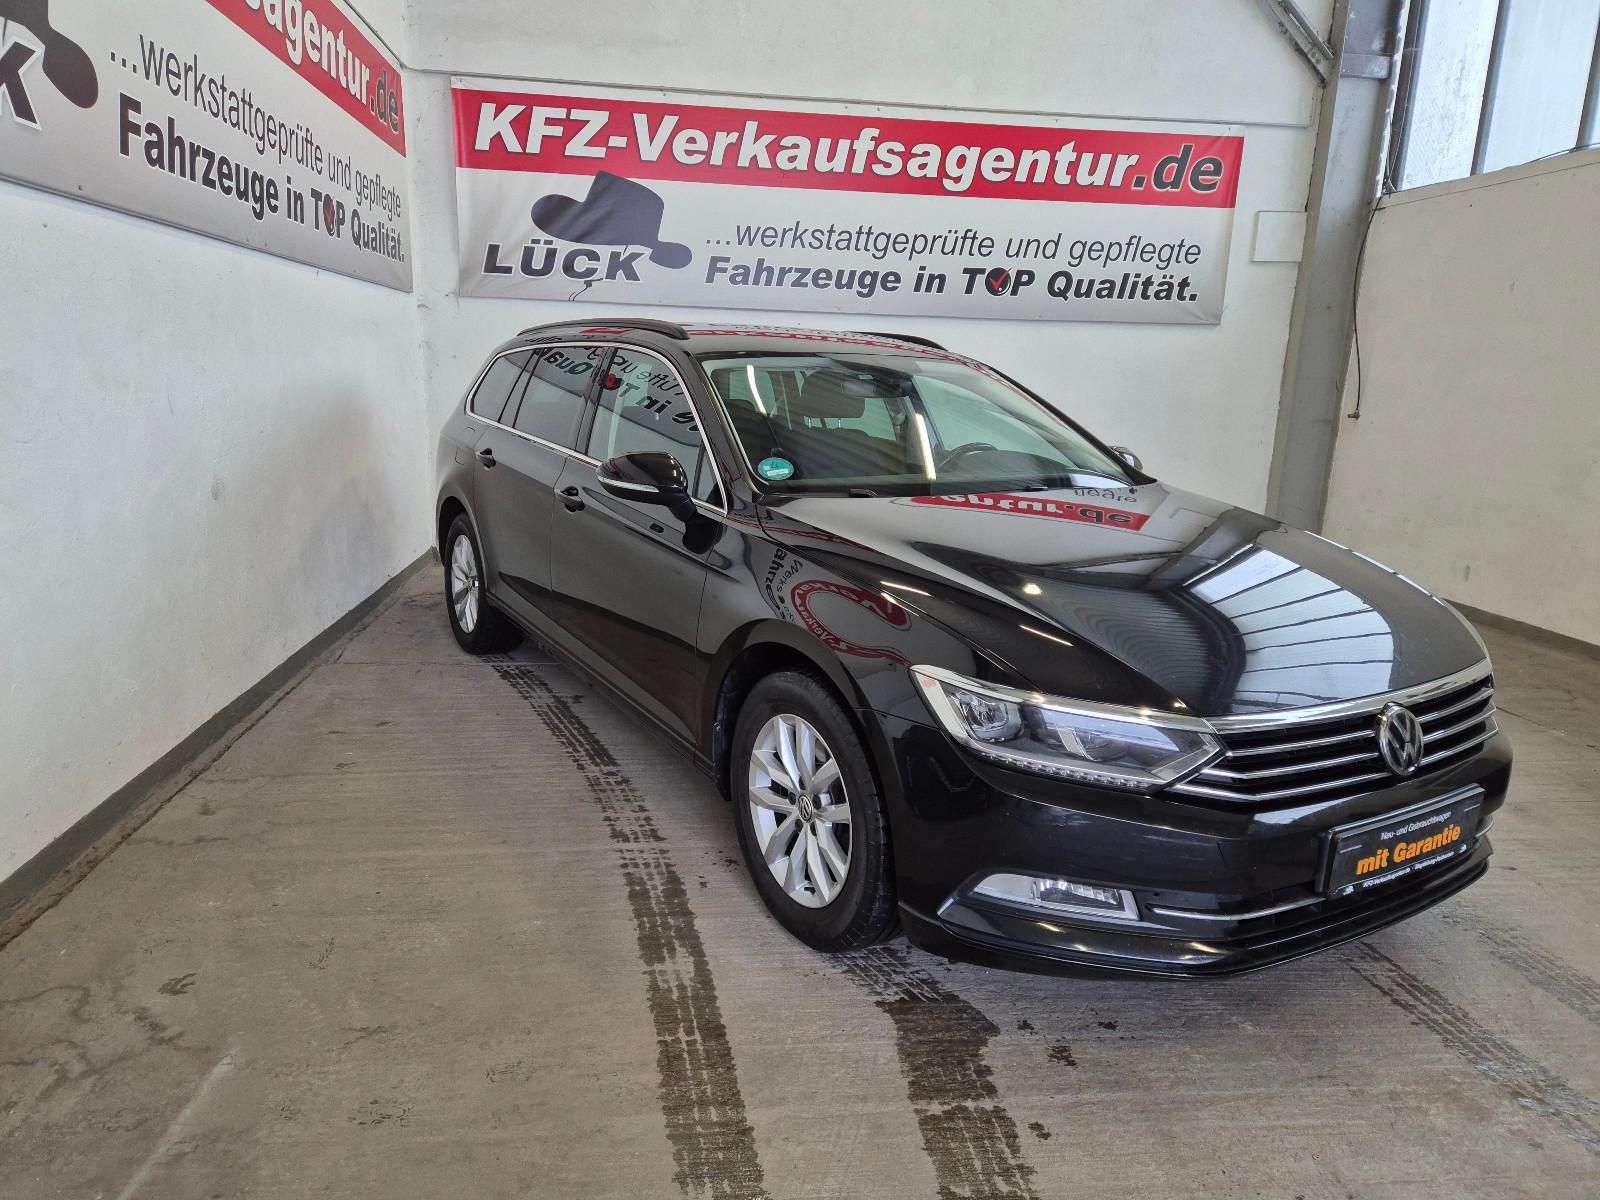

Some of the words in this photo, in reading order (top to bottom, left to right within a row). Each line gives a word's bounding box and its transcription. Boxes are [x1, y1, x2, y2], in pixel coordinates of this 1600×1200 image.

[245, 0, 400, 135] agentur.de
[119, 91, 279, 221] Fahrzeuge
[285, 174, 304, 225] in
[350, 208, 404, 263] Qualität.
[474, 102, 1224, 193] KFZ-Verkaufsagentur.de
[327, 151, 352, 192] und
[355, 170, 401, 221] gepflegte
[482, 238, 642, 283] LÜCK
[705, 221, 995, 261] ...werkstattgeprüfte
[1004, 233, 1063, 260] und
[1068, 235, 1202, 271] gepflegte
[704, 255, 902, 299] Fahrzeuge
[912, 265, 948, 294] in
[1046, 269, 1199, 302] Qualität.
[1356, 848, 1390, 876] mit
[1393, 823, 1462, 864] Garantie
